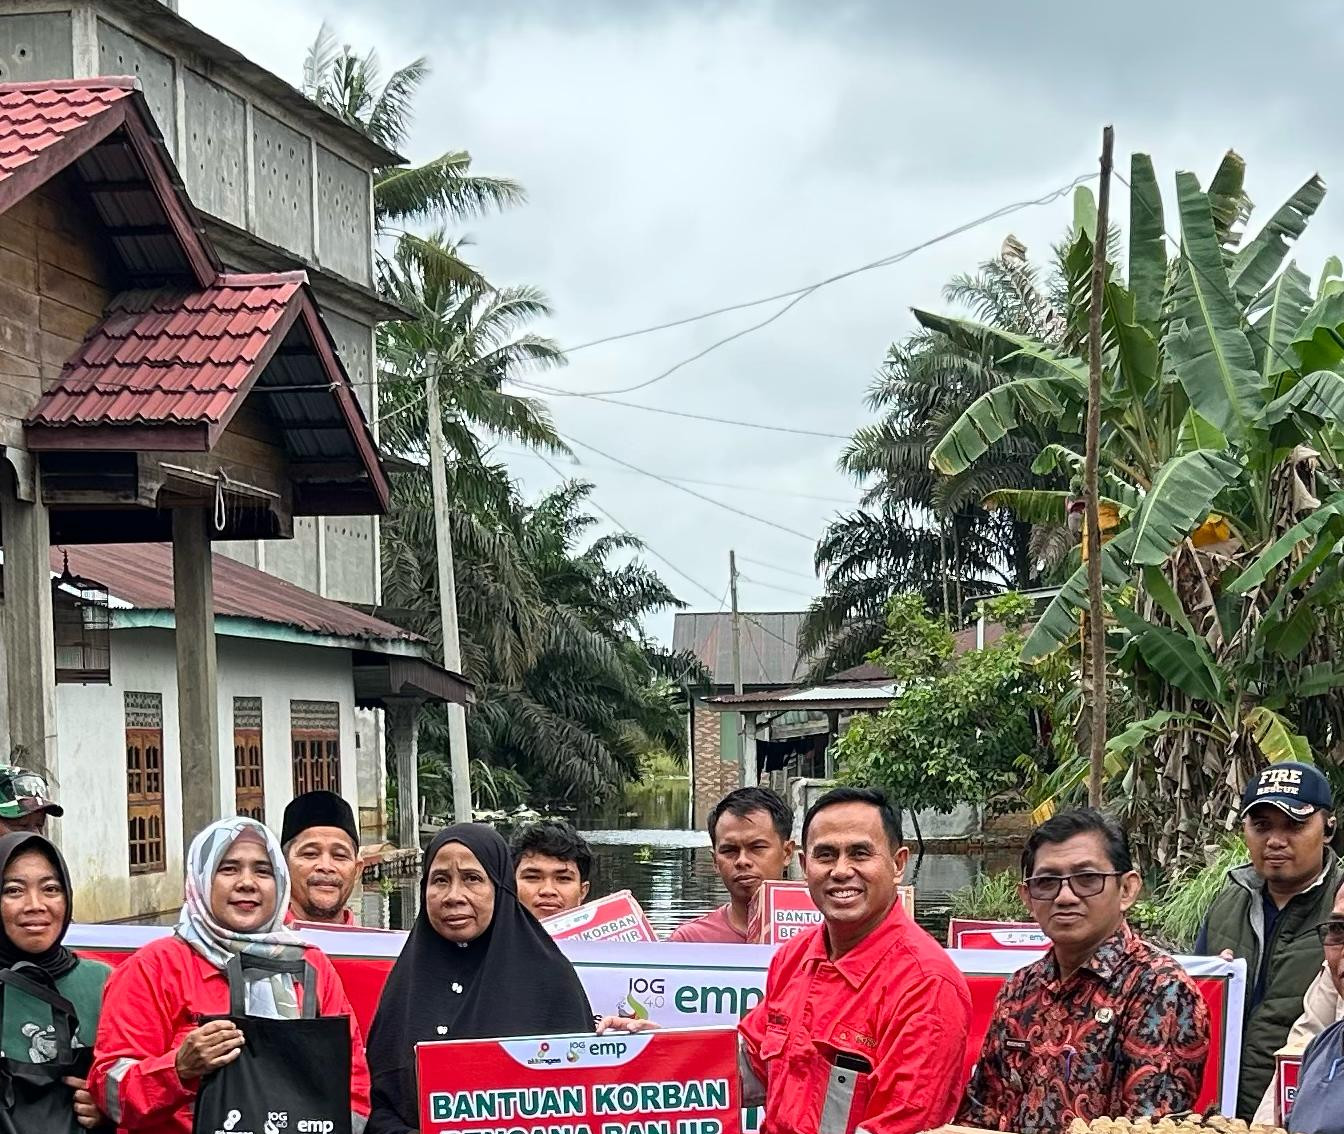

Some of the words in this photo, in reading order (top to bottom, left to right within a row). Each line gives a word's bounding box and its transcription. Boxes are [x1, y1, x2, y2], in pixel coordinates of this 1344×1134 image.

[1259, 769, 1302, 785] FIRE
[1257, 785, 1299, 796] RESCUE
[583, 915, 636, 941] KORBAN
[589, 1041, 627, 1058] emp
[431, 1087, 585, 1122] BANTUAN
[594, 1080, 728, 1114] KORBAN
